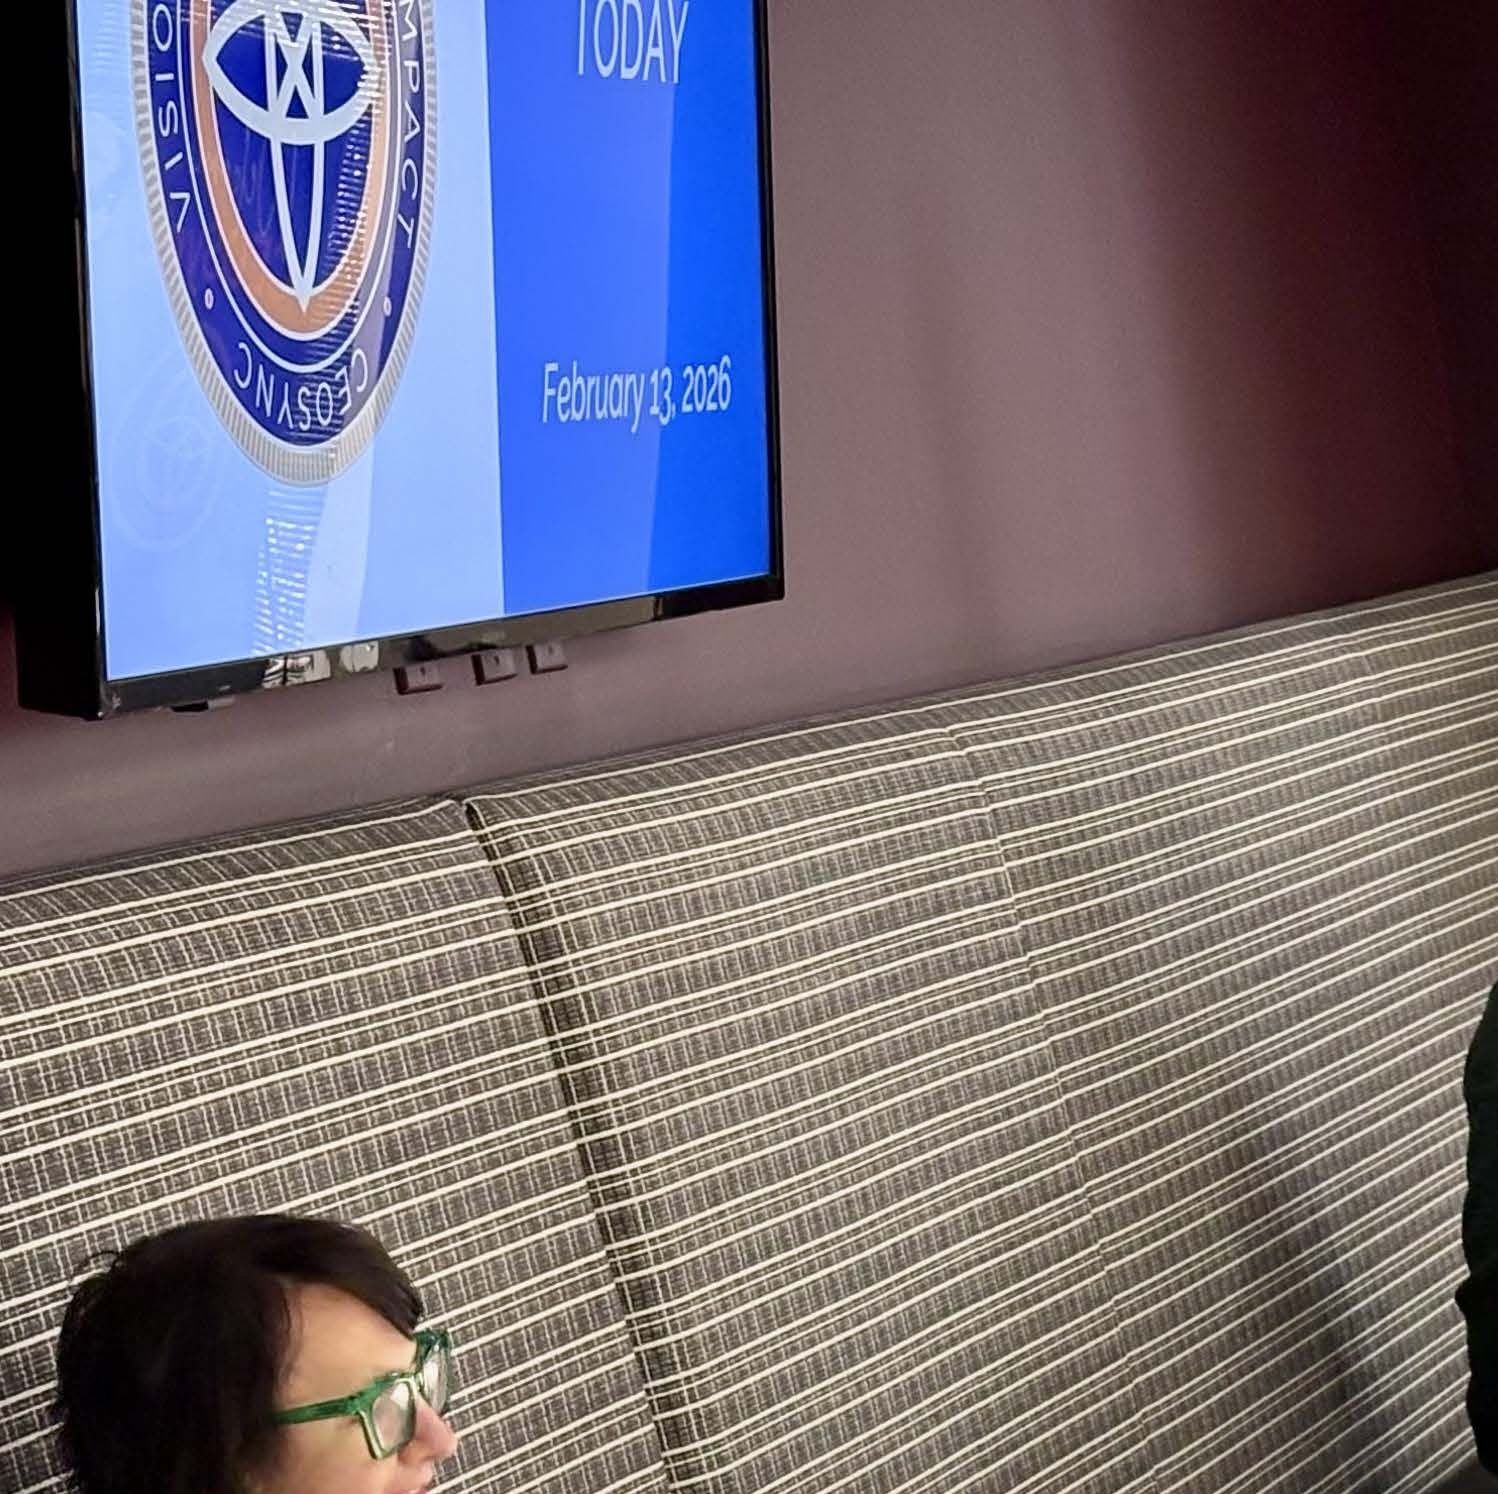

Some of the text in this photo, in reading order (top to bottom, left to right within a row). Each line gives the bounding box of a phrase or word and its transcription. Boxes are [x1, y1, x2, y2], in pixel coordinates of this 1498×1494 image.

[577, 0, 689, 84] TODAY
[152, 3, 191, 232] VISIO
[397, 0, 420, 248] MPACT
[233, 342, 368, 431] CEOSYNC
[542, 354, 732, 434] February 13, 2026
